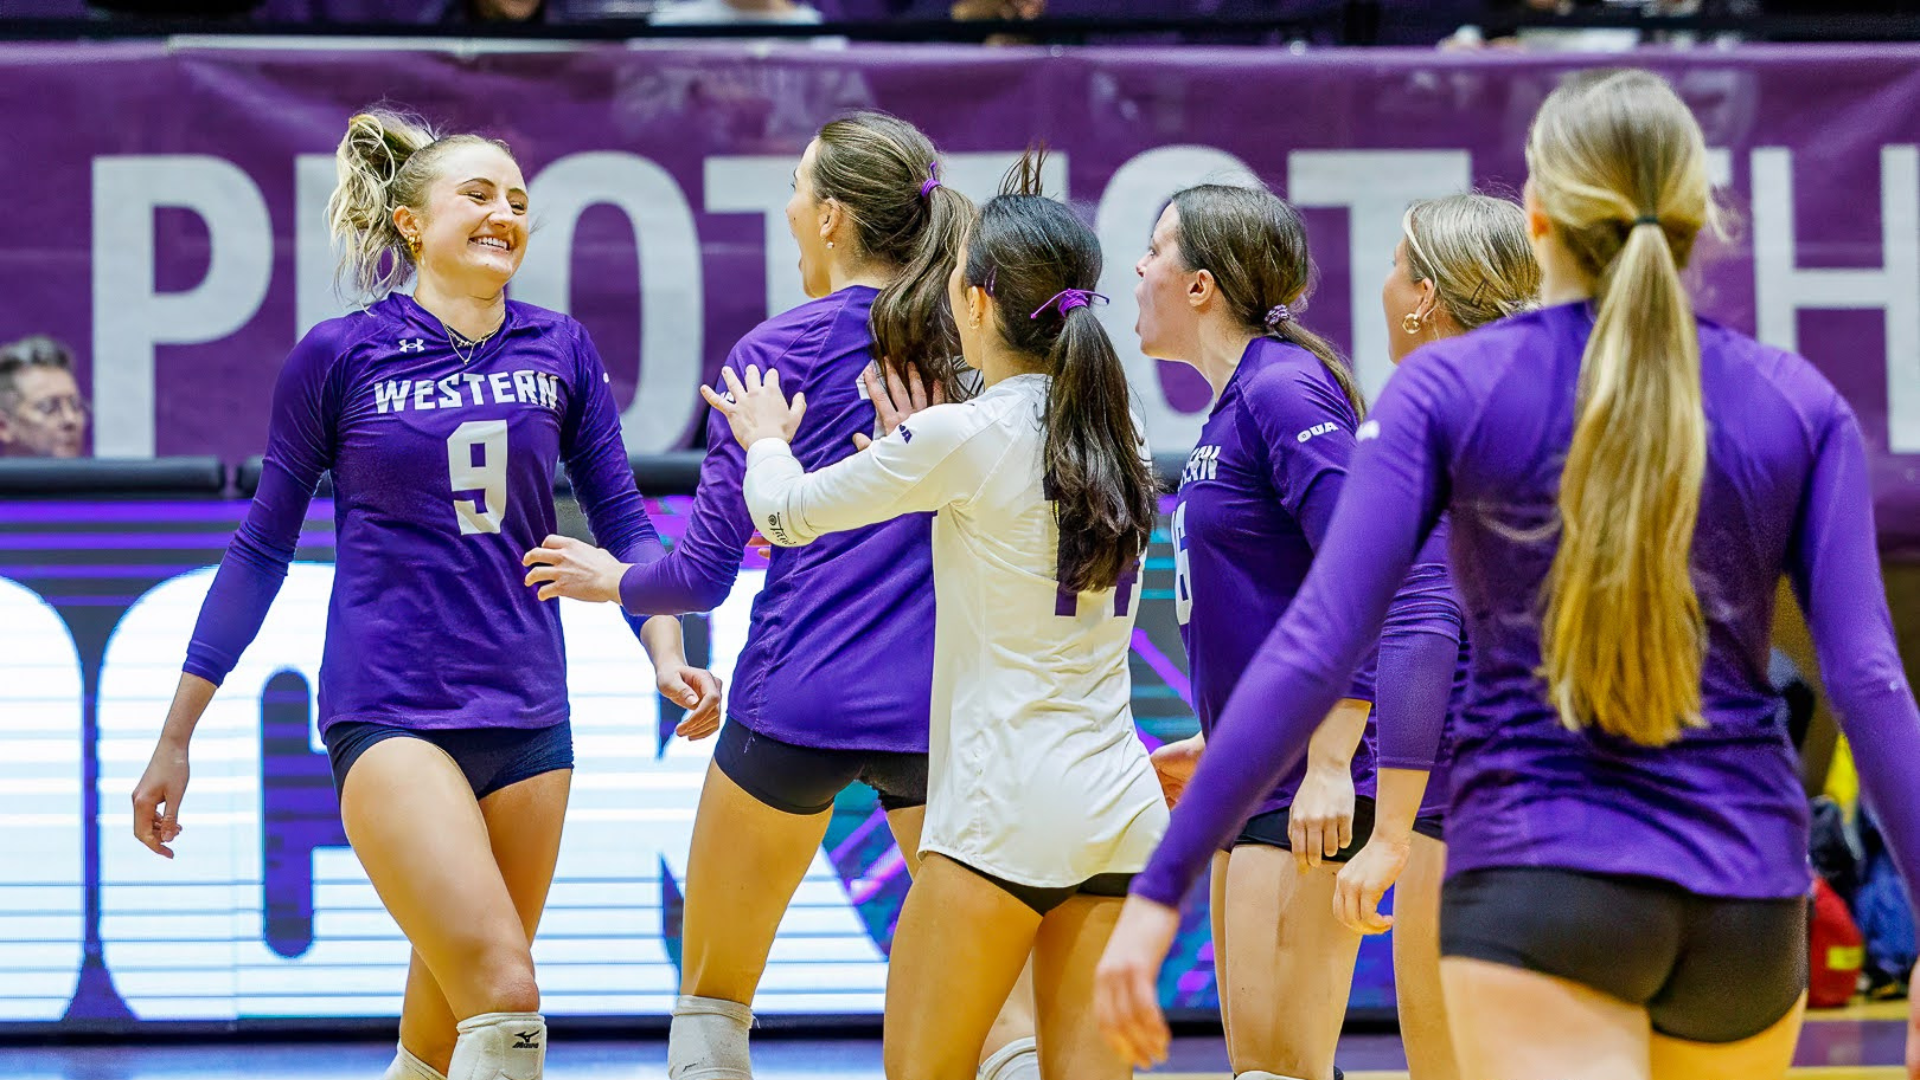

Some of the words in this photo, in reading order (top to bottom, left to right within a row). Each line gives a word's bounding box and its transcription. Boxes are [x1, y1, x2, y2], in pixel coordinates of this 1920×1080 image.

[373, 369, 560, 414] WESTERN
[1297, 421, 1339, 443] OUA
[446, 418, 508, 536] 9
